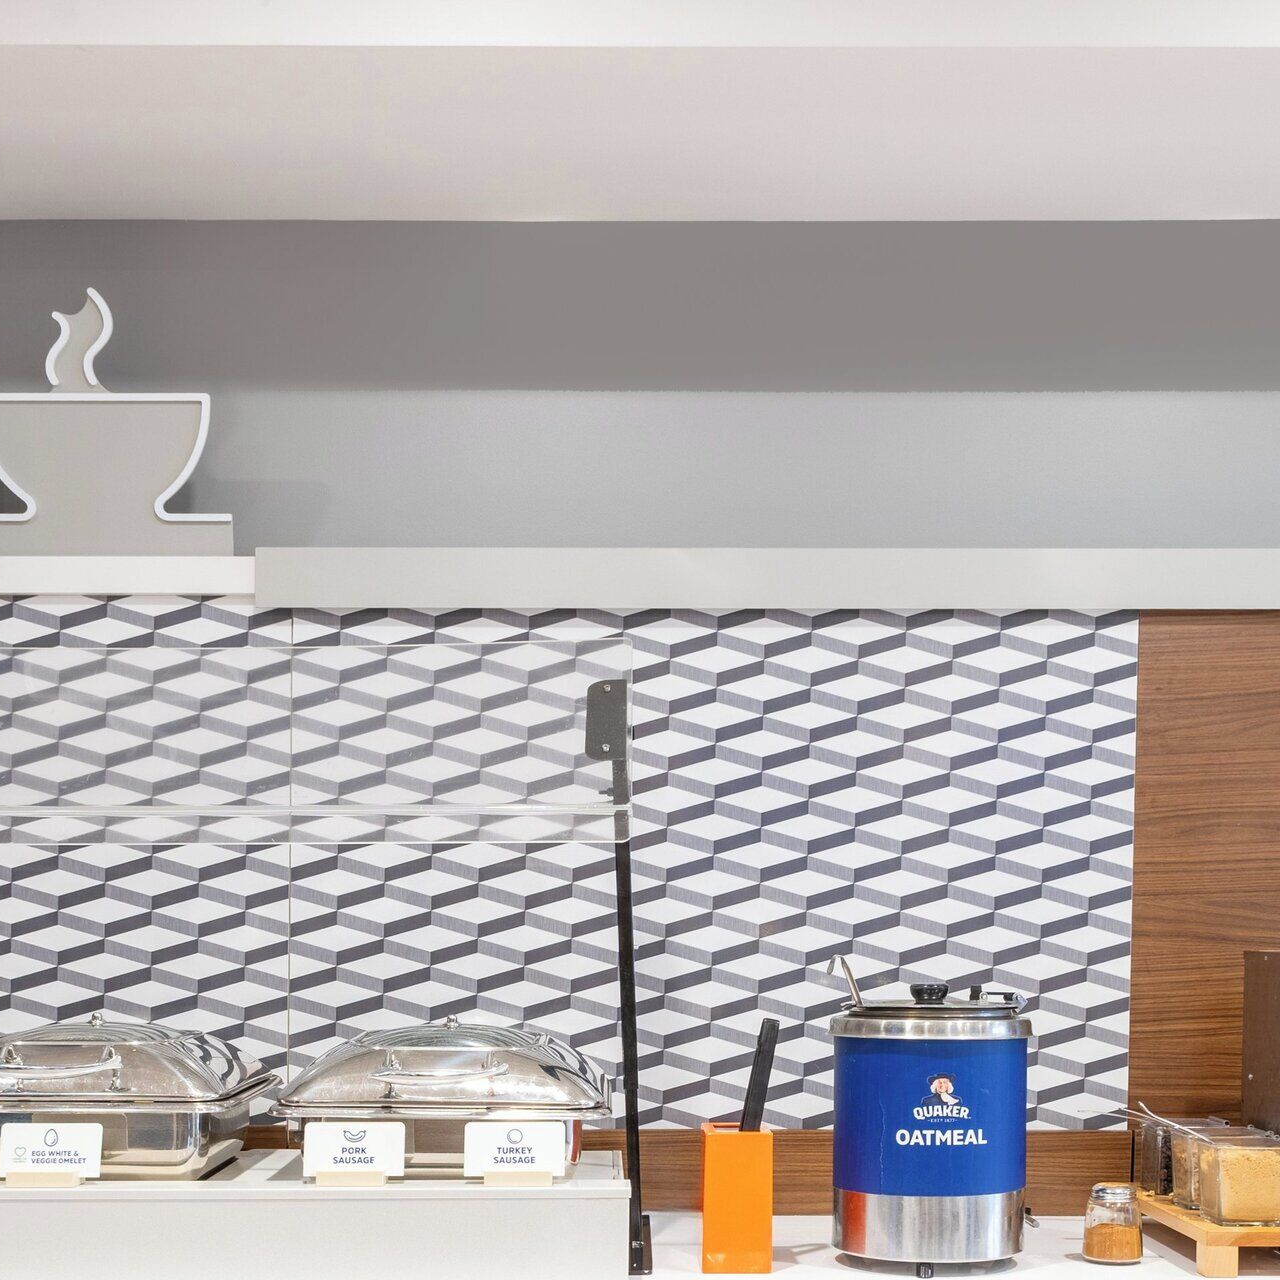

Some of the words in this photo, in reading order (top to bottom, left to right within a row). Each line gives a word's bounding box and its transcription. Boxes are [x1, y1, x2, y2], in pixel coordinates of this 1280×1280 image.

[913, 1105, 970, 1120] QUAKER
[895, 1128, 988, 1146] OATMEAL
[341, 1147, 367, 1155] PORK
[497, 1147, 533, 1155] TURKEY
[332, 1156, 375, 1164] SAUSAGE
[493, 1156, 536, 1164] SAUSAGE
